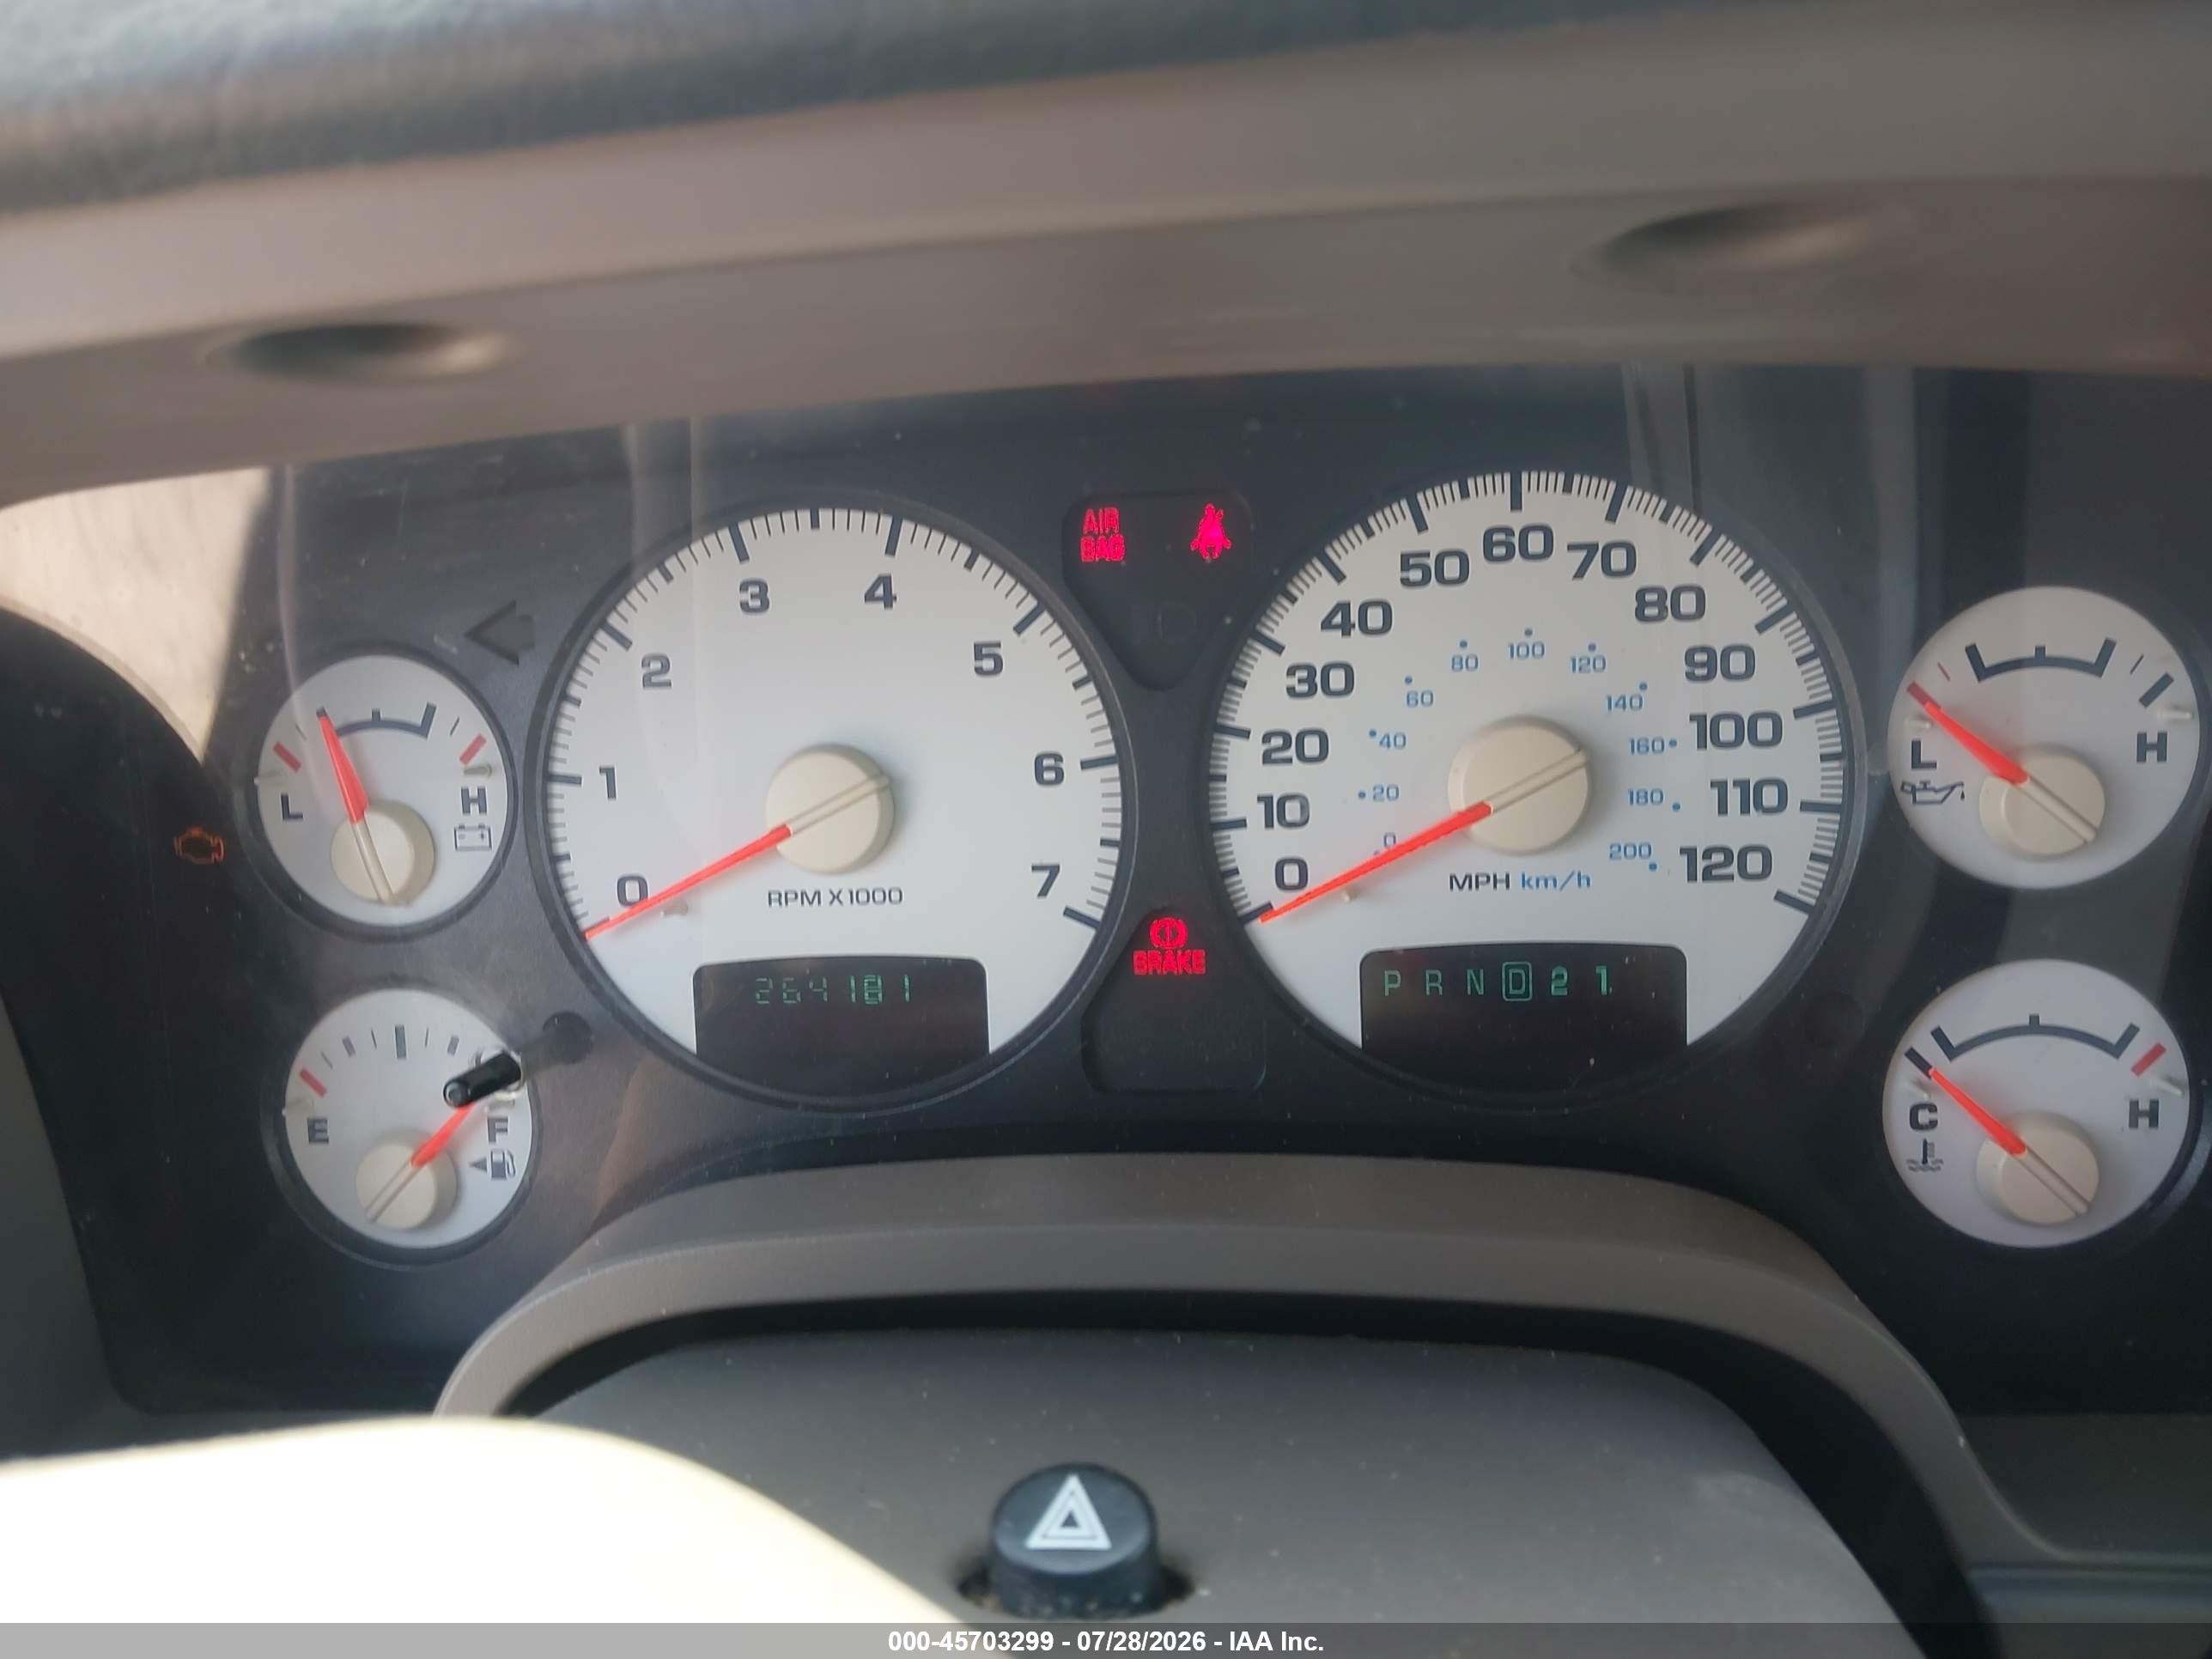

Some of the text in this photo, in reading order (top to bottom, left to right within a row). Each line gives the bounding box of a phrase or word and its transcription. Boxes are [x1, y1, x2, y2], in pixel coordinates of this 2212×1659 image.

[1083, 507, 1120, 534] AIR
[1080, 534, 1125, 562] BAG
[1483, 525, 1553, 562] 60
[1400, 550, 1469, 587] 50
[1567, 541, 1637, 579] 70
[739, 579, 769, 613] 3
[864, 574, 896, 609] 4
[1635, 585, 1705, 623] 80
[1321, 599, 1392, 637] 40
[973, 641, 1003, 676] 5
[1451, 654, 1479, 672] 80
[1509, 642, 1546, 659] 100
[1571, 655, 1606, 673] 120
[1685, 644, 1755, 682] 90
[641, 653, 672, 689] 2
[1286, 662, 1355, 698] 30
[1407, 690, 1433, 707] 60
[1607, 694, 1643, 712] 140
[1378, 733, 1407, 750] 40
[1630, 738, 1665, 755] 160
[1690, 712, 1783, 750] 100
[1261, 729, 1329, 765] 20
[1911, 739, 1937, 770] L
[2136, 732, 2167, 763] H
[599, 766, 617, 799] 1
[1034, 752, 1064, 786] 6
[281, 794, 303, 821] L
[461, 787, 487, 815] H
[1373, 785, 1400, 802] 20
[1629, 788, 1663, 805] 180
[1711, 779, 1789, 816] 110
[1257, 794, 1310, 829] 10
[1382, 833, 1396, 848] 0
[1609, 842, 1652, 860] 200
[1274, 858, 1308, 890] 0
[1680, 845, 1772, 883] 120
[617, 875, 648, 906] 0
[1031, 864, 1060, 897] 7
[1449, 870, 1591, 891] MPH km/h
[769, 890, 822, 908] RPM
[1133, 949, 1206, 975] BRAKE
[1384, 965, 1611, 996] P R N D 2 1
[488, 1116, 508, 1143] F
[1909, 1102, 1938, 1132] C
[2129, 1099, 2160, 1129] H
[307, 1117, 329, 1144] E
